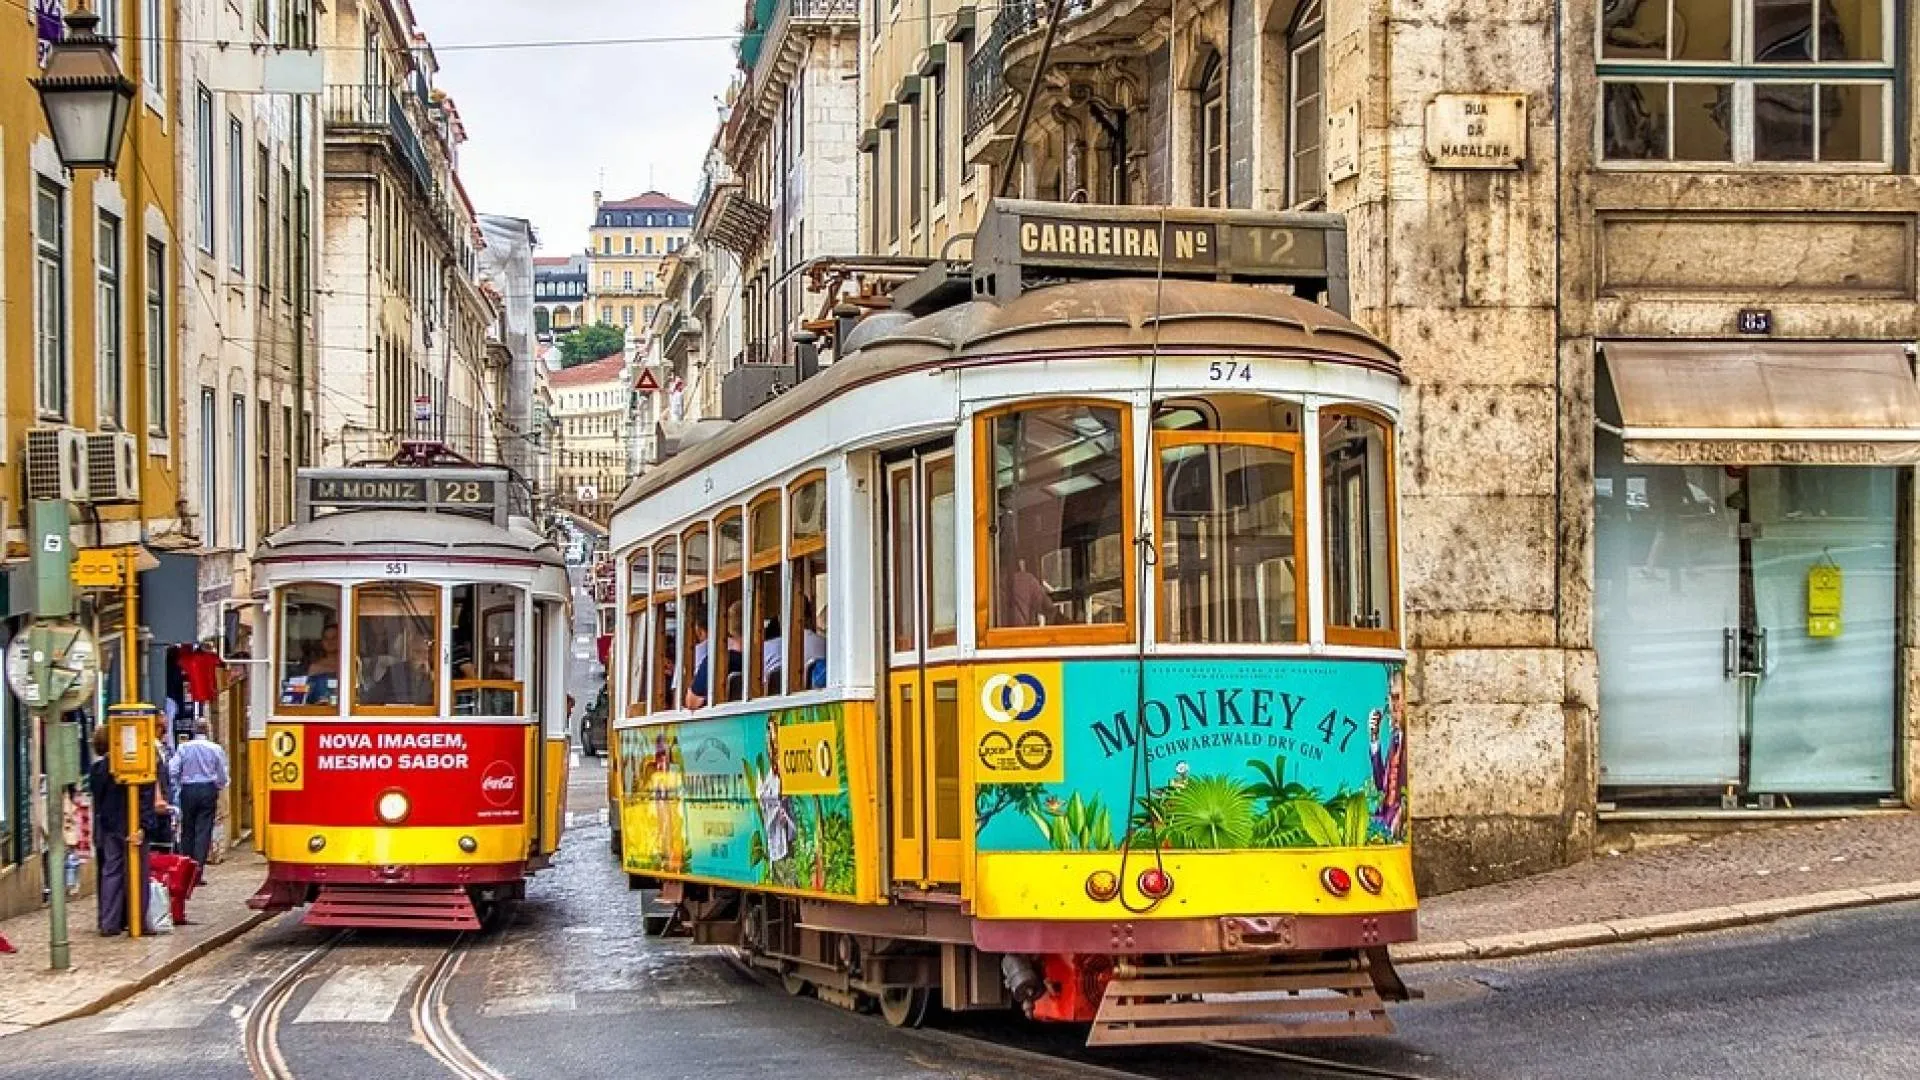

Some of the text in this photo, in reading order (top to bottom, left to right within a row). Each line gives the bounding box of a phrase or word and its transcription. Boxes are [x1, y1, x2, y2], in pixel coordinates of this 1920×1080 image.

[1465, 103, 1489, 116] RUA
[1021, 222, 1295, 264] CARREIRA Nº 12
[1209, 361, 1252, 382] 574
[343, 481, 417, 498] MONIZ
[445, 482, 481, 502] 28
[385, 562, 408, 575] 551
[1090, 687, 1358, 759] MONKEY 47
[319, 732, 468, 751] NOVA IMAGEM,
[1146, 732, 1324, 763] SCHWARZWALD DRY GIN
[317, 753, 469, 770] MESMO SABOR
